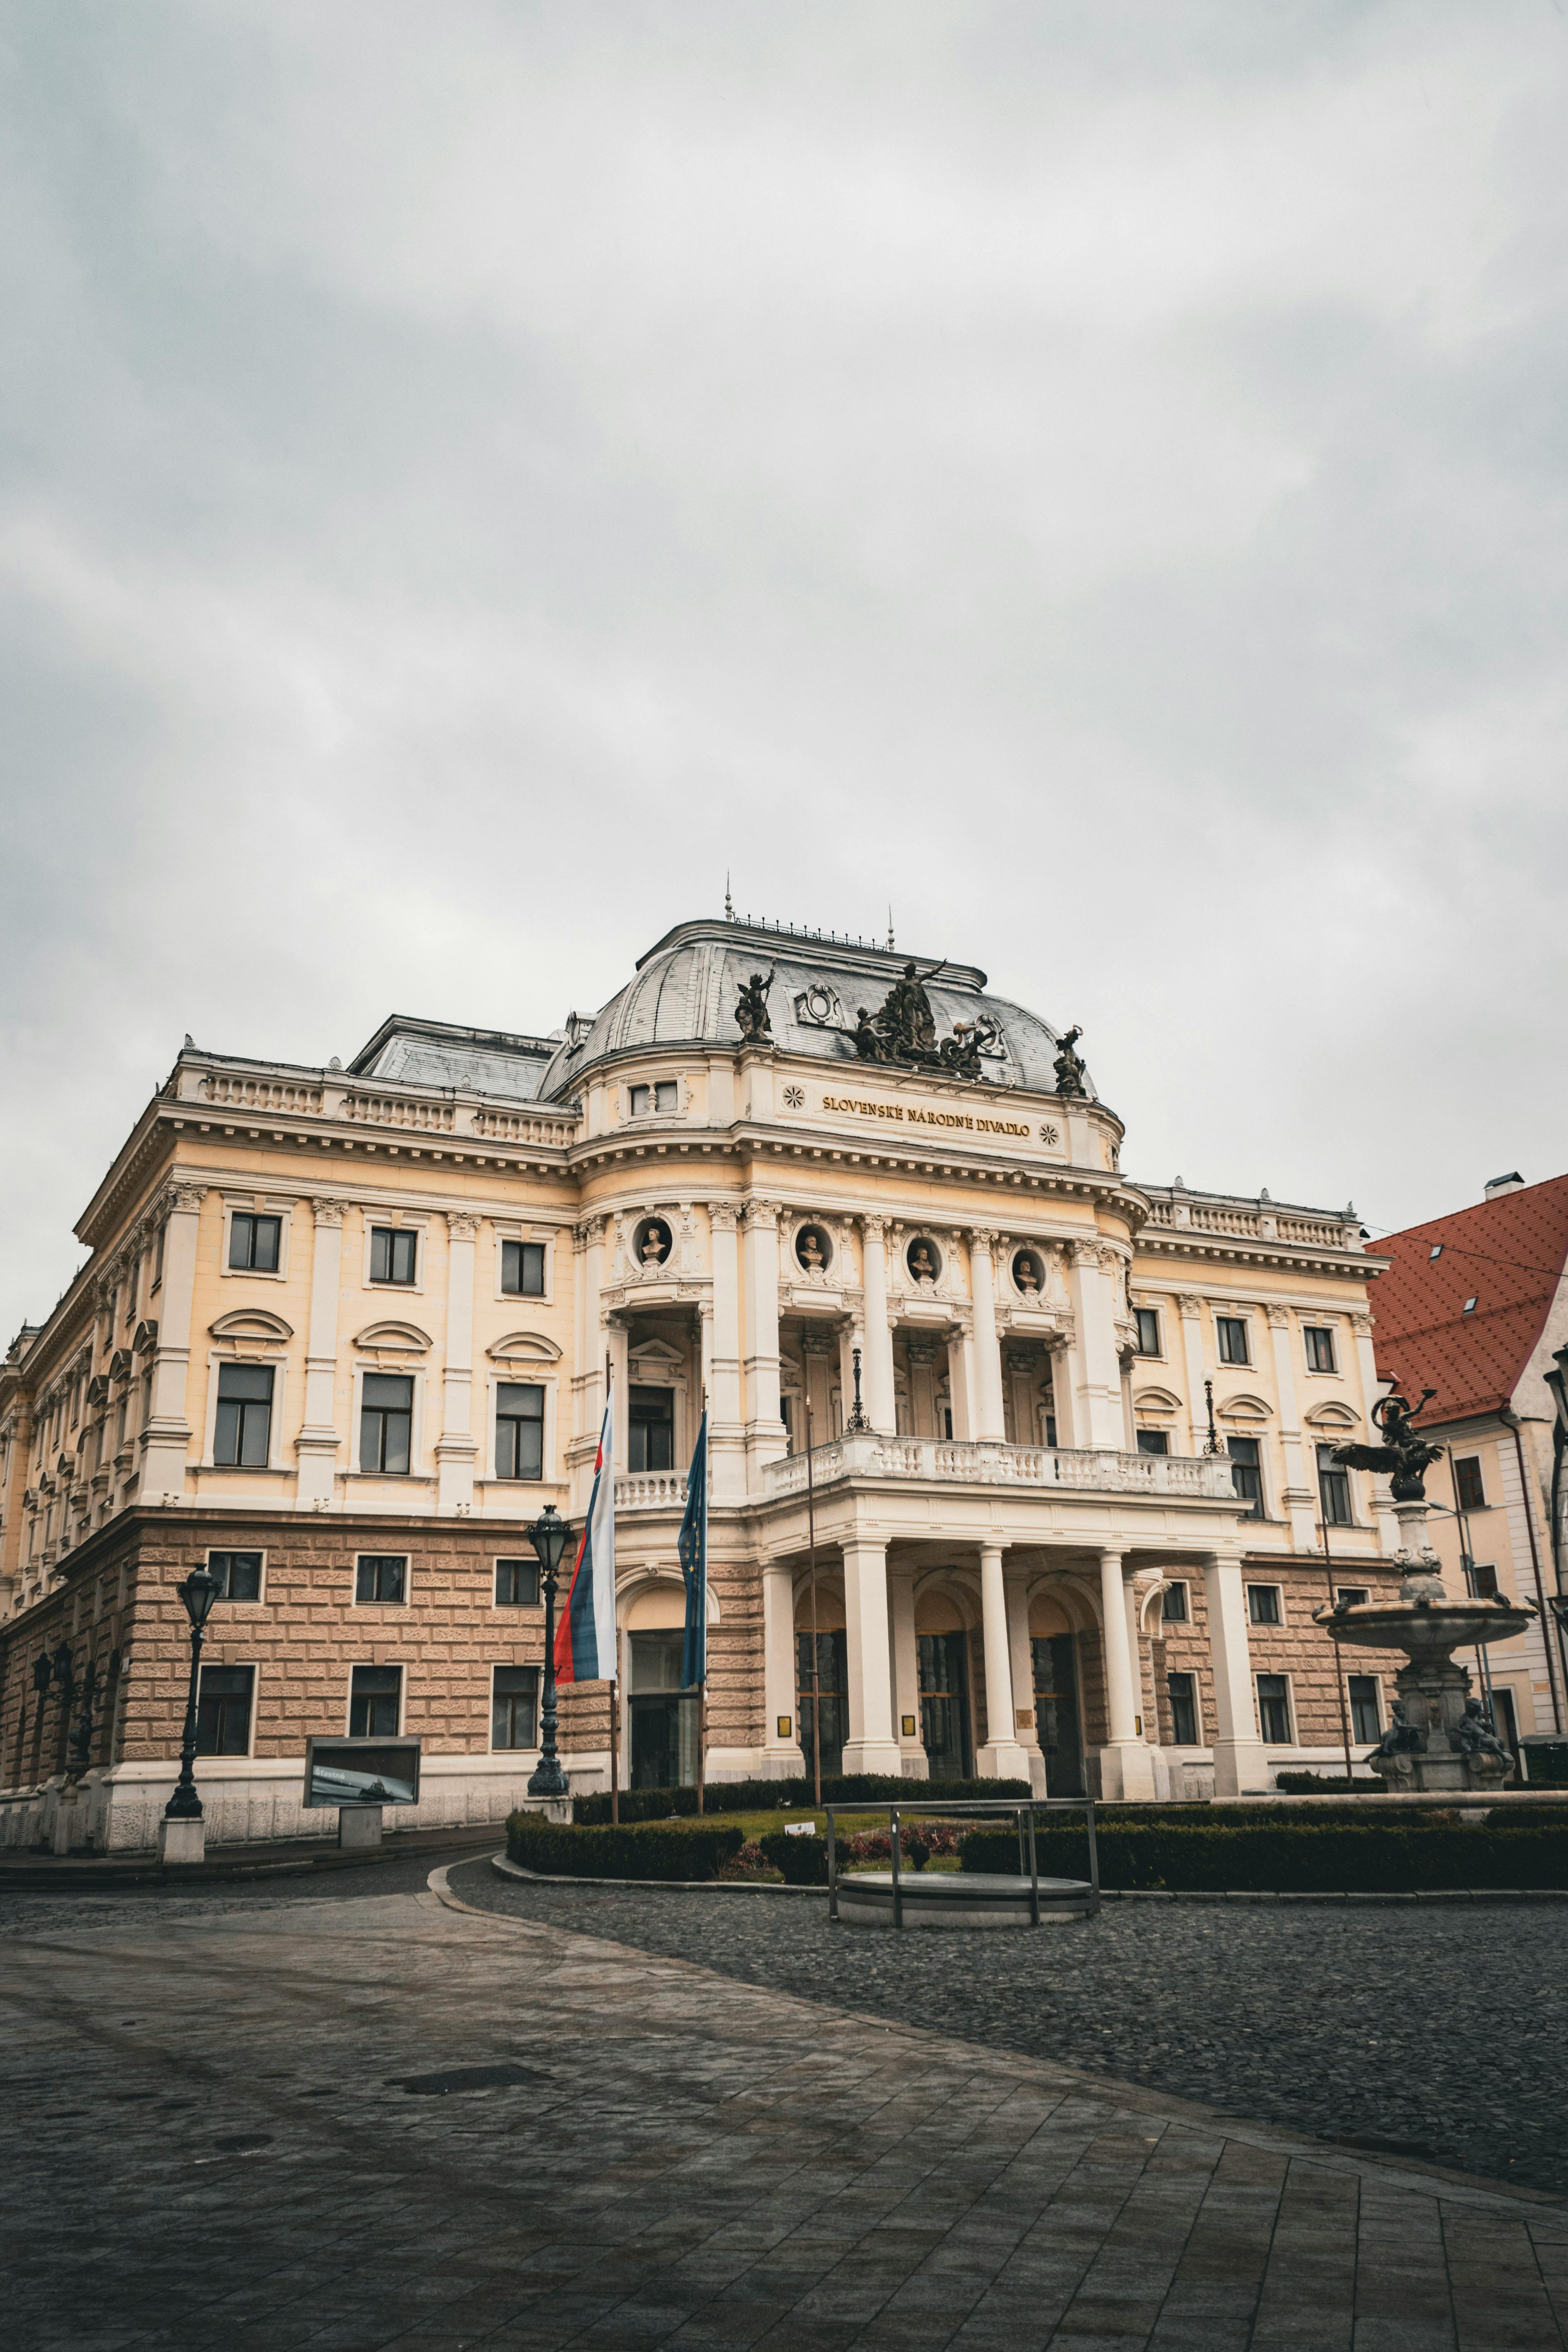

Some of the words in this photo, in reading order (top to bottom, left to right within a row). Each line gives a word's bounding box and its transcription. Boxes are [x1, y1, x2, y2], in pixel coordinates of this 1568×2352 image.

[823, 1097, 903, 1120] SLOVENSKÉ
[908, 1106, 973, 1129] NÁRODNÉ
[976, 1119, 1030, 1136] DIVADLO
